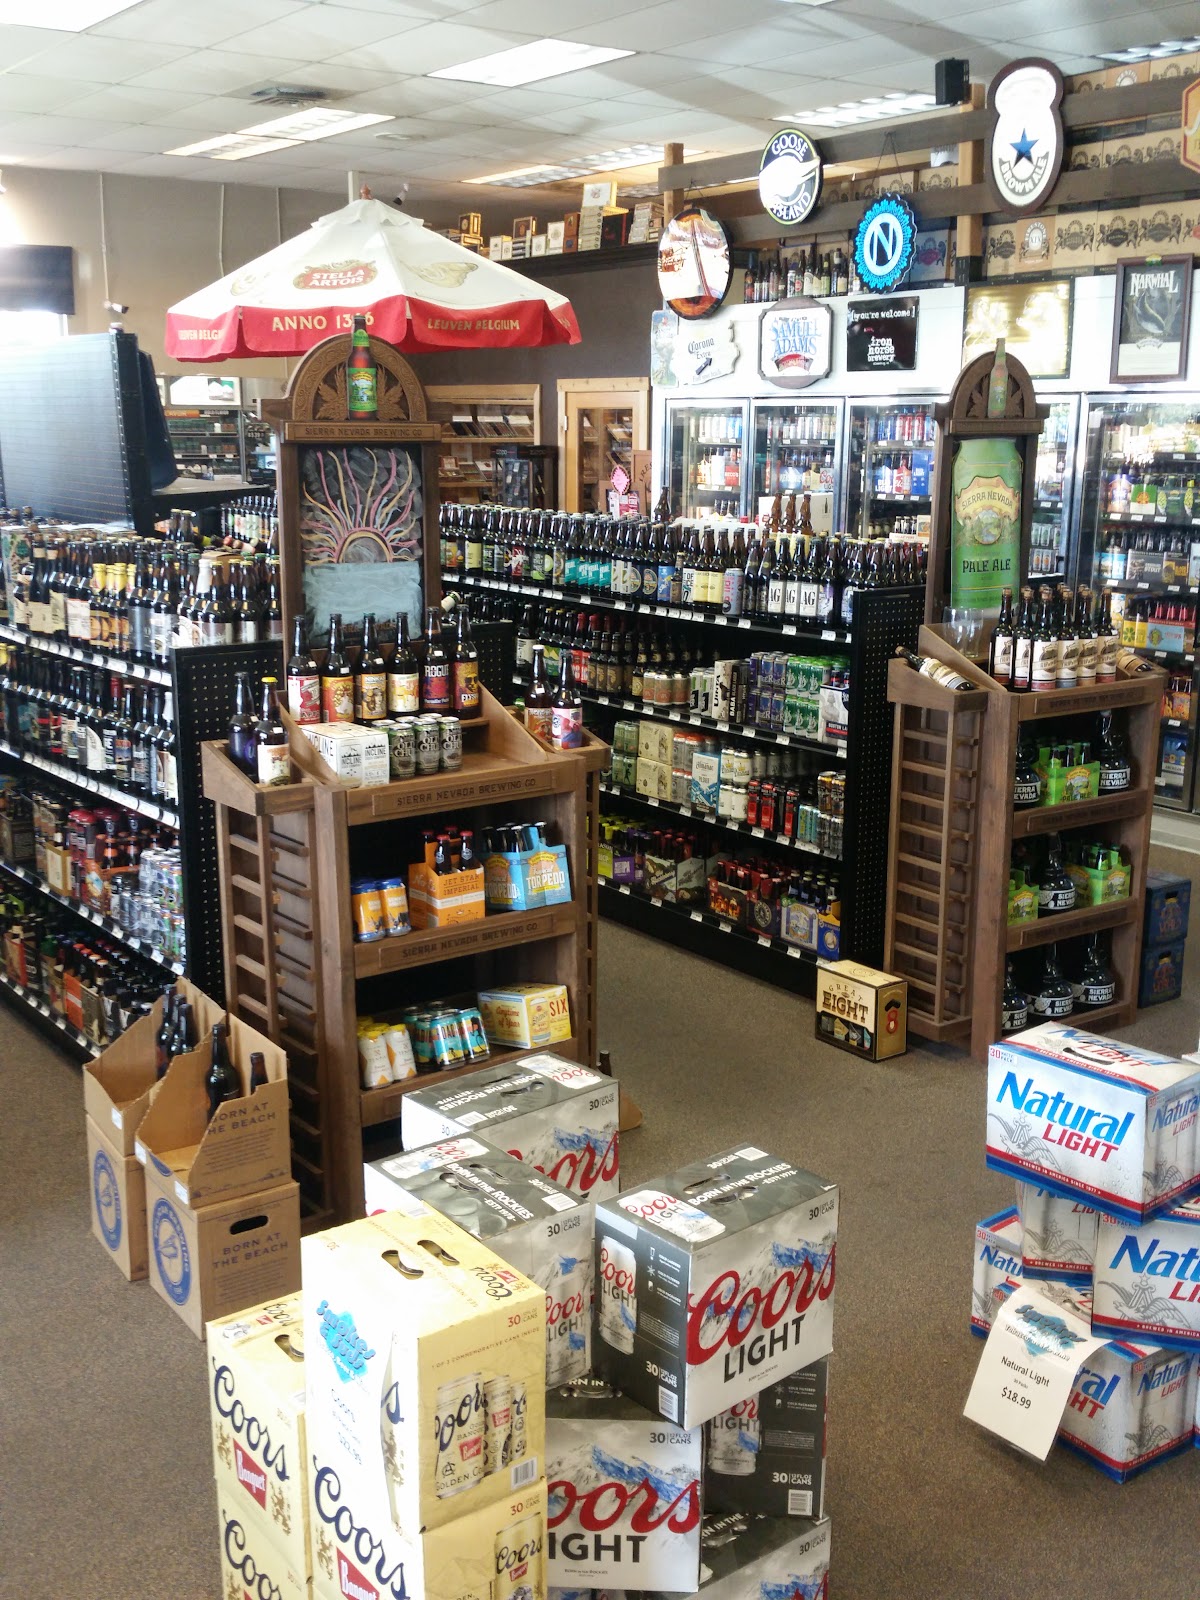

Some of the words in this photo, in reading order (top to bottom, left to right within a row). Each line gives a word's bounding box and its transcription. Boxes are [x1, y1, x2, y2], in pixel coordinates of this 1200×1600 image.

[771, 134, 808, 155] GOOSE
[1001, 162, 1032, 193] BROWN
[1032, 156, 1049, 184] ALE
[771, 191, 812, 219] ISLAND
[872, 222, 897, 266] N
[309, 276, 364, 287] ARTOIS
[312, 269, 365, 280] STELLA
[1129, 270, 1179, 297] NARWHAL
[272, 315, 327, 331] ANNO
[336, 311, 375, 329] 136
[881, 309, 911, 318] welcome
[427, 318, 472, 330] LEUVEN
[475, 319, 520, 331] BELGIUM
[772, 318, 822, 339] SAMUEL
[688, 338, 714, 354] Corona
[774, 337, 817, 357] ADAMS
[868, 345, 895, 354] horse
[871, 336, 893, 346] iron
[867, 354, 896, 362] brewery
[305, 427, 337, 436] SIERRA
[338, 427, 370, 436] NEVADA
[374, 427, 410, 436] BREWING
[961, 491, 987, 511] SIERRA
[987, 490, 1014, 510] NEVADA
[962, 559, 989, 573] PALE
[992, 558, 1011, 572] ALE
[397, 793, 432, 806] SIERRA
[436, 787, 475, 800] NEVADA
[478, 780, 522, 795] BREWING
[443, 877, 457, 887] JET
[443, 884, 480, 896] IMPERIAL
[526, 871, 565, 889] TORPEDO
[403, 943, 437, 958] SIERRA
[440, 935, 478, 950] NEVADA
[482, 926, 524, 942] BREWING
[829, 984, 863, 1001] GREAT
[549, 998, 567, 1017] SIX
[823, 991, 868, 1024] EIGHT
[886, 1007, 898, 1034] 8
[990, 1047, 1001, 1059] 30
[1047, 1029, 1179, 1066] Natural
[1076, 1044, 1151, 1067] LIGHT
[254, 1102, 269, 1112] AT
[589, 1099, 599, 1111] 30
[996, 1071, 1135, 1146] Natural
[232, 1112, 276, 1130] BEACH
[1172, 1113, 1197, 1136] LIGHT
[1042, 1123, 1119, 1163] LIGHT
[687, 1186, 722, 1206] BORN
[720, 1183, 729, 1193] IN
[728, 1178, 750, 1191] THE
[745, 1162, 791, 1182] ROCKIES
[1023, 1161, 1042, 1174] BREWED
[1042, 1167, 1049, 1175] IN
[1049, 1170, 1070, 1183] AMERICA
[1070, 1177, 1085, 1188] SINCE
[447, 1162, 470, 1180] BORN
[478, 1180, 494, 1194] THE
[493, 1190, 534, 1220] ROCKIES
[808, 1206, 820, 1220] 30
[822, 1204, 835, 1216] CANS
[266, 1232, 281, 1243] AT
[547, 1223, 560, 1237] 30
[563, 1221, 581, 1232] CANS
[977, 1230, 986, 1240] 30
[223, 1239, 260, 1255] BORN
[244, 1241, 288, 1261] BEACH
[213, 1256, 239, 1269] THE
[1034, 1260, 1056, 1268] BREWED
[603, 1280, 637, 1309] LIGHT
[686, 1241, 837, 1366] Coors
[508, 1314, 521, 1328] 30
[523, 1312, 538, 1324] CANS
[548, 1314, 584, 1342] LIGHT
[1142, 1325, 1165, 1333] BREWED
[1175, 1329, 1200, 1338] AMERICA
[452, 1340, 503, 1364] COMMEMORATIVE
[505, 1333, 520, 1344] CANS
[521, 1327, 540, 1338] INSIDE
[723, 1313, 806, 1383] LIGHT
[646, 1361, 658, 1377] 30
[661, 1375, 678, 1388] CANS
[1001, 1355, 1029, 1377] Natural
[1030, 1370, 1050, 1388] Light
[1137, 1353, 1195, 1396] Natural
[592, 1379, 604, 1387] IN
[1073, 1366, 1121, 1406] ral
[1161, 1375, 1188, 1398] LIGHT
[1001, 1386, 1031, 1409] $18.99
[212, 1356, 290, 1482] Coors
[713, 1416, 760, 1432] LIGHT
[650, 1432, 665, 1444] 30
[669, 1437, 691, 1445] CANS
[236, 1449, 266, 1494] Banquet
[771, 1472, 788, 1484] 30
[791, 1478, 812, 1486] CANS
[511, 1502, 523, 1516] 30
[313, 1455, 411, 1600] Coors
[715, 1520, 726, 1530] IN
[724, 1513, 744, 1526] THE
[496, 1536, 542, 1575] Coors
[549, 1532, 648, 1563] IGHT
[800, 1541, 811, 1556] 30
